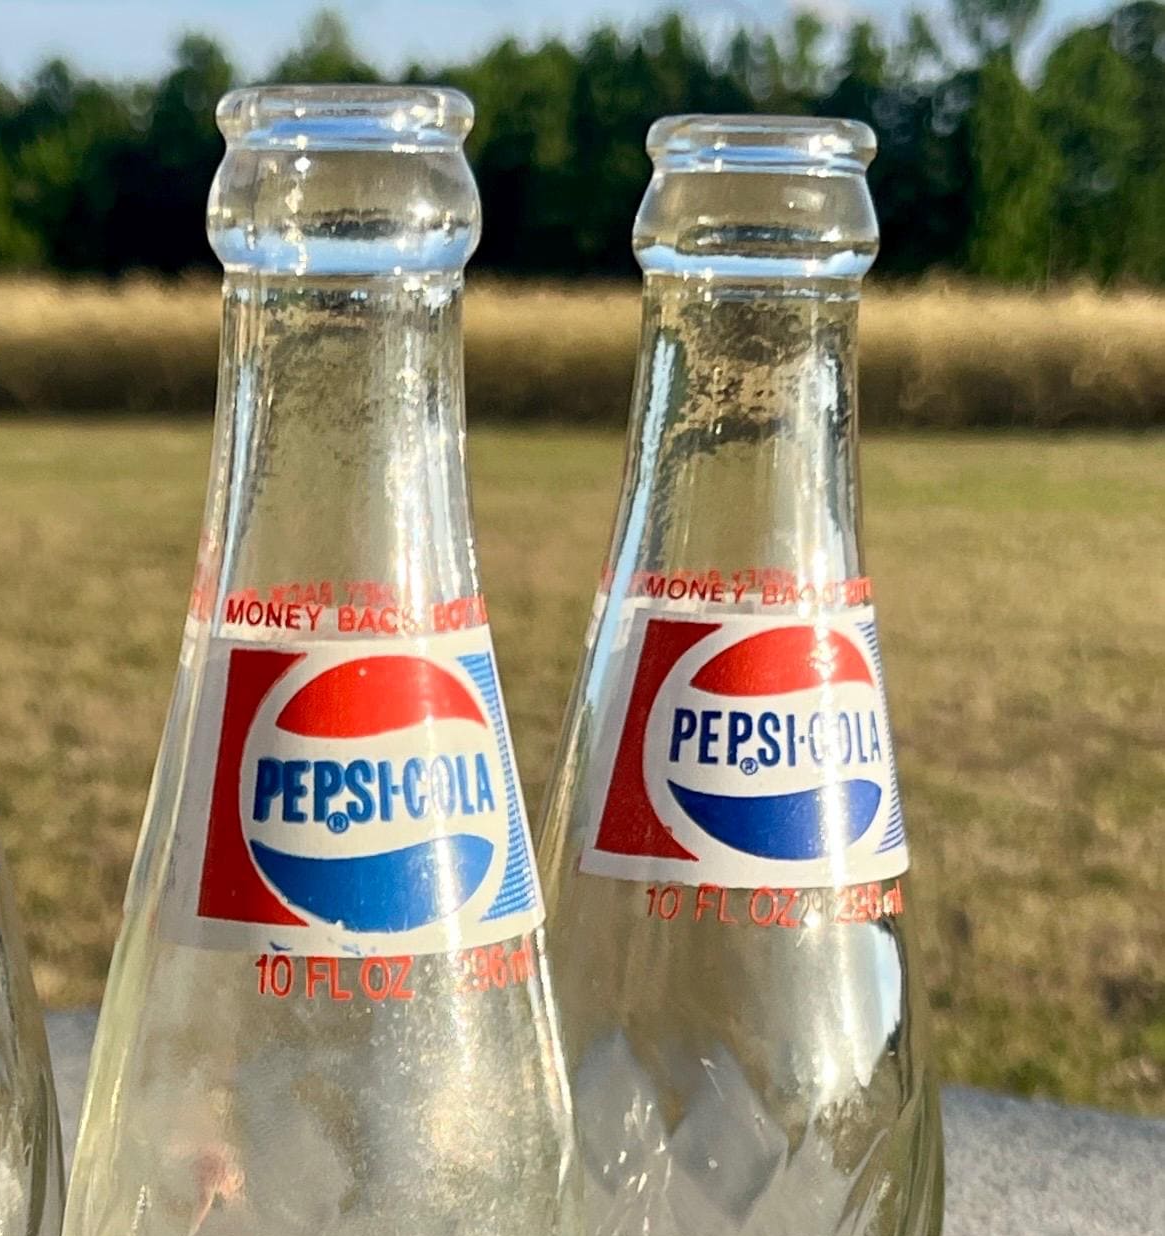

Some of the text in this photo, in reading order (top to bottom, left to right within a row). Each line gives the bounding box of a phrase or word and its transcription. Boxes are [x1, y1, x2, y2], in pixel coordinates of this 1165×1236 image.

[646, 577, 744, 603] MONEY
[226, 599, 323, 632] MONEY
[646, 886, 679, 921] 10
[695, 884, 735, 923] FL
[749, 886, 800, 927] OZ
[256, 954, 292, 997] 10
[307, 956, 352, 1000] FL
[360, 956, 415, 1001] OZ
